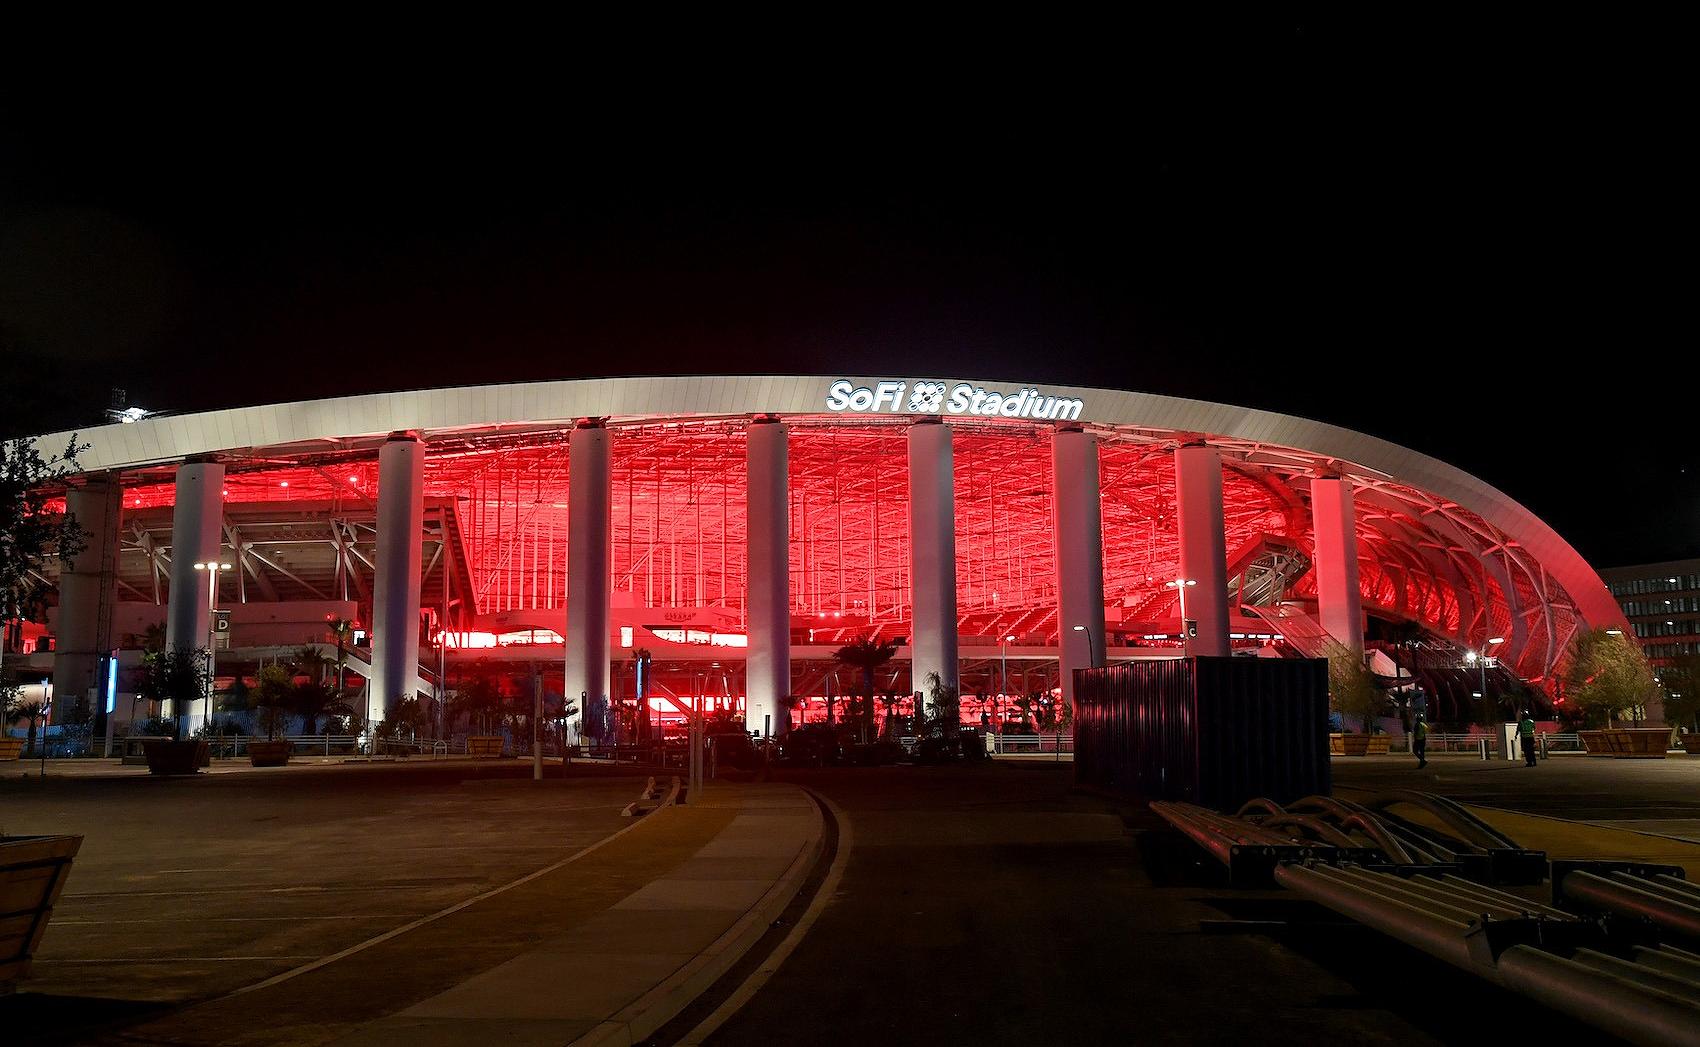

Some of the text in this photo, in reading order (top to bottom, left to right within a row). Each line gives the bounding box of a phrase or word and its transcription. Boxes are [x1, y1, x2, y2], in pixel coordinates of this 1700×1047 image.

[826, 379, 1085, 421] SoFi Stadium
[218, 619, 229, 630] D
[1188, 627, 1197, 637] C
